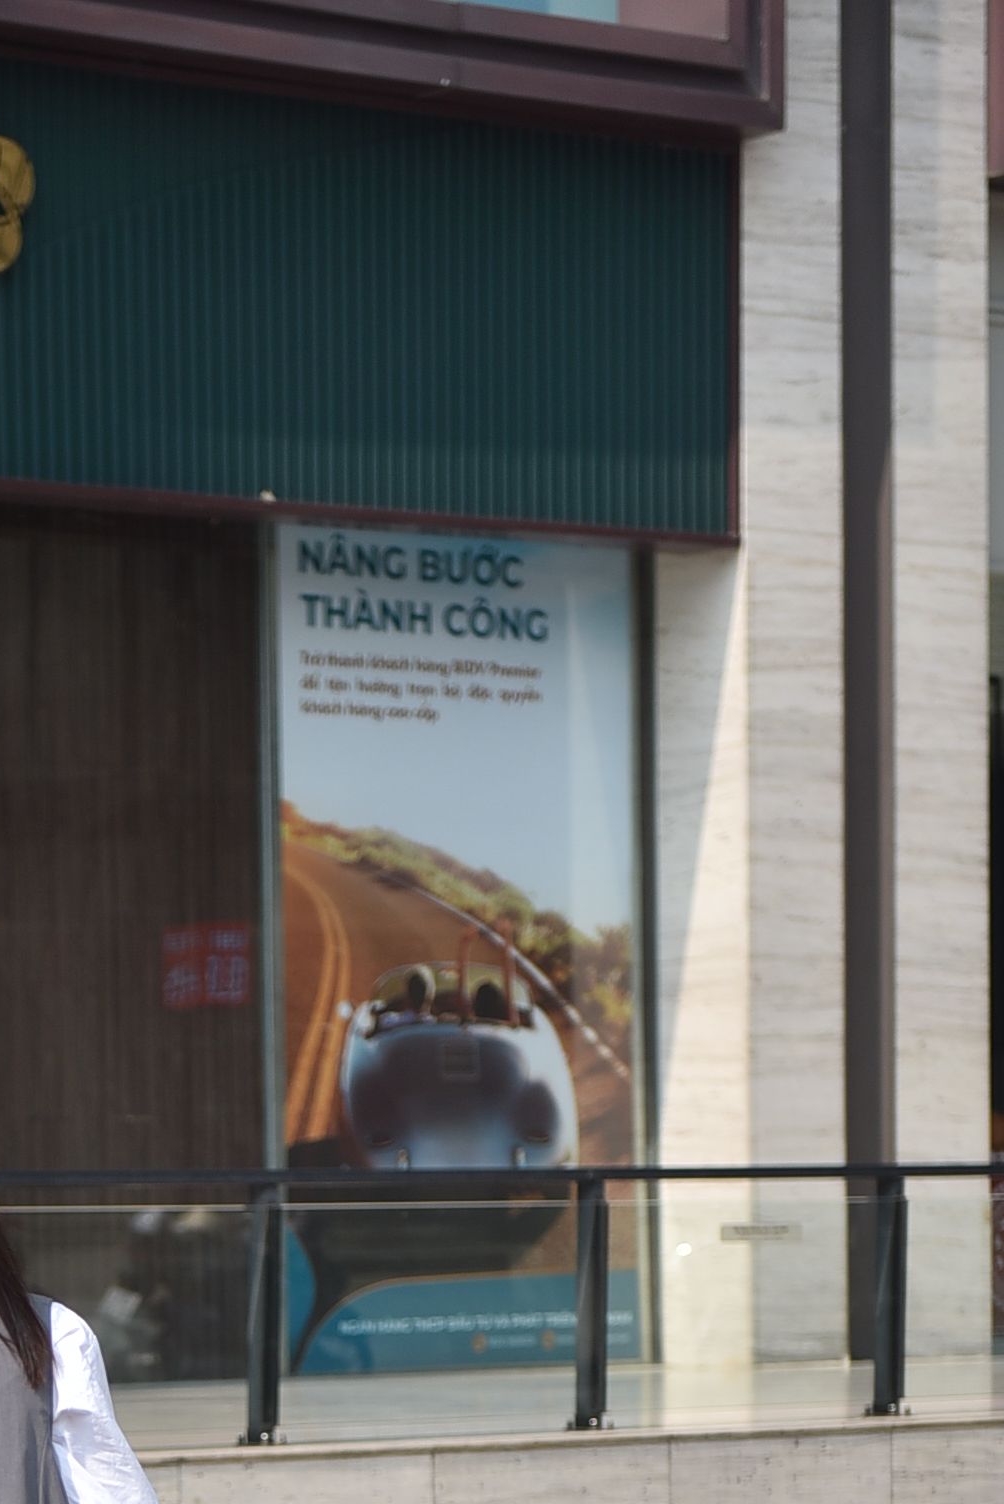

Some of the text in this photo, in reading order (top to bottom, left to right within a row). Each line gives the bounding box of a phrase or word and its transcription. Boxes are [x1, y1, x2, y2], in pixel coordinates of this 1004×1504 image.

[298, 532, 525, 588] NÂNG BƯỚC
[301, 587, 549, 642] THÀNH CÔNG
